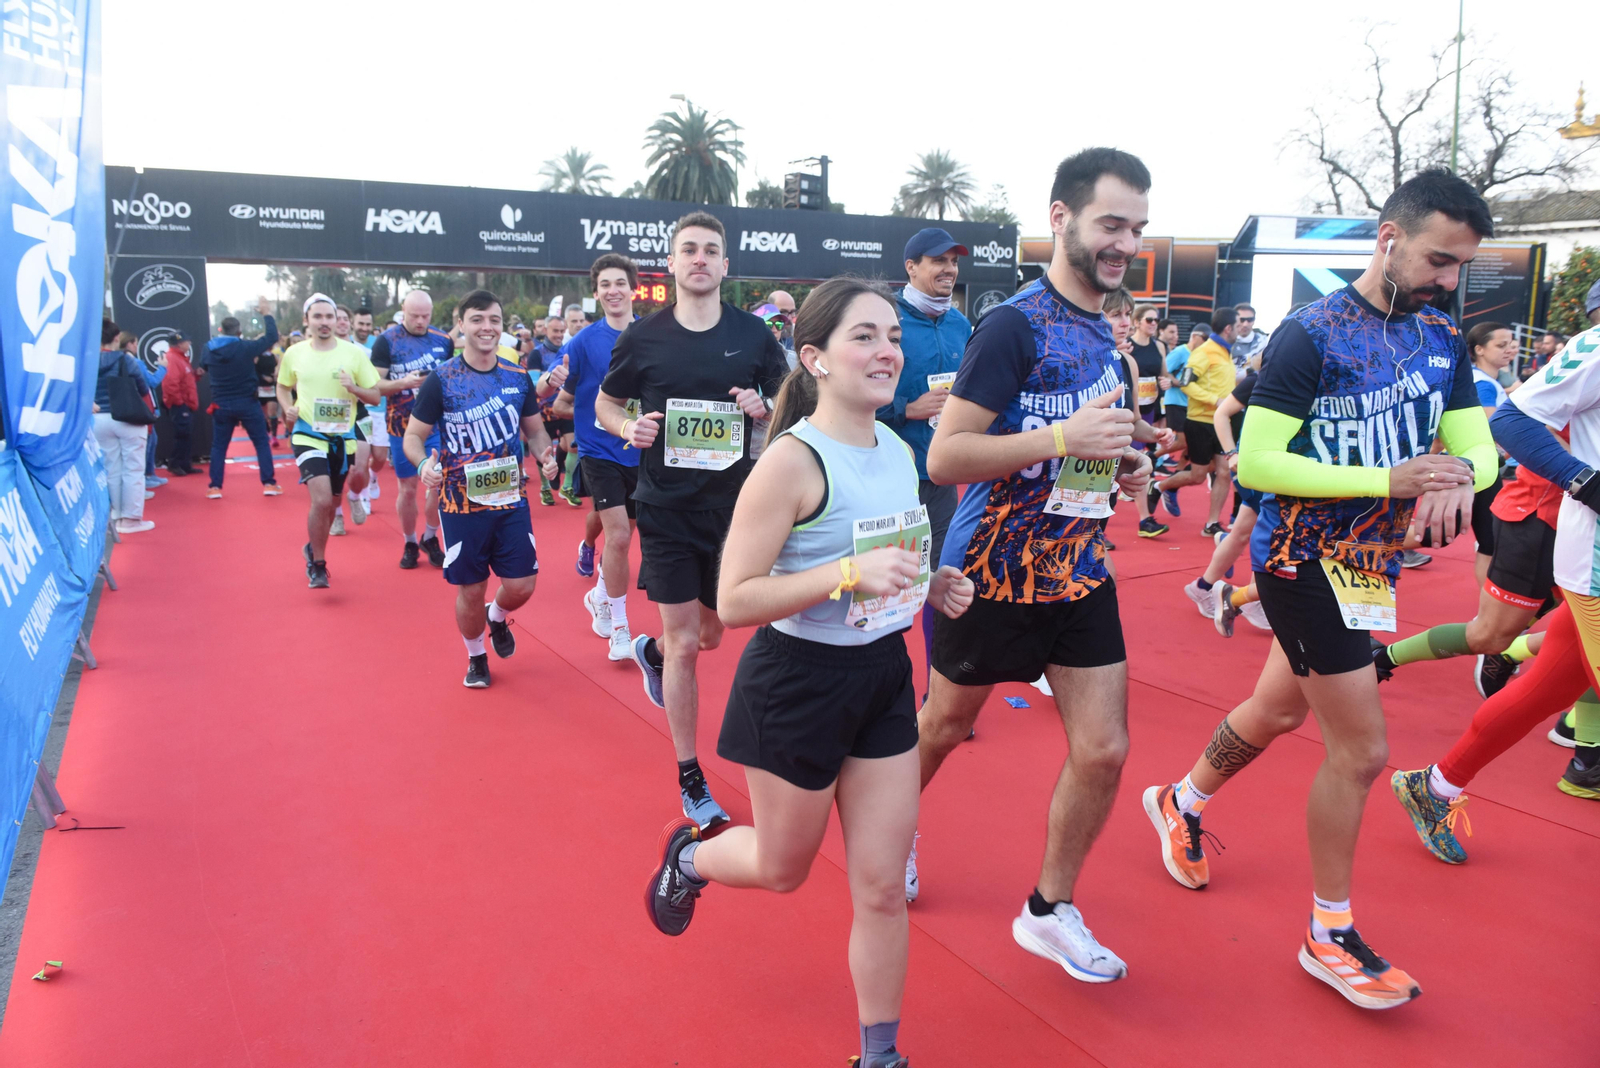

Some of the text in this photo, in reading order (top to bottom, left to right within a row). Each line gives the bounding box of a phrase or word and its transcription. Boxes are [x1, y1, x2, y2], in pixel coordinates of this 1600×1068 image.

[31, 0, 61, 71] HU
[259, 206, 325, 221] HYUNDAI
[365, 208, 444, 235] HOKA
[114, 222, 159, 231] AYNTAMIENTO
[302, 222, 325, 230] Motor
[484, 244, 539, 254] Healthcare Partner
[739, 230, 798, 254] HOKA
[841, 241, 882, 252] HYUNDAI
[7, 84, 83, 437] HOKA
[631, 284, 666, 301] 4:18
[1020, 391, 1073, 418] MEDIO
[1077, 363, 1120, 409] MARATÓN
[319, 405, 344, 417] 6834
[465, 396, 505, 422] MARATÓN
[712, 402, 733, 413] SEVILLA
[1308, 396, 1358, 419] MEDIO
[445, 404, 520, 455] SEVILLA
[677, 416, 725, 439] 8703
[475, 470, 507, 489] 8630
[658, 864, 672, 897] HOKA
